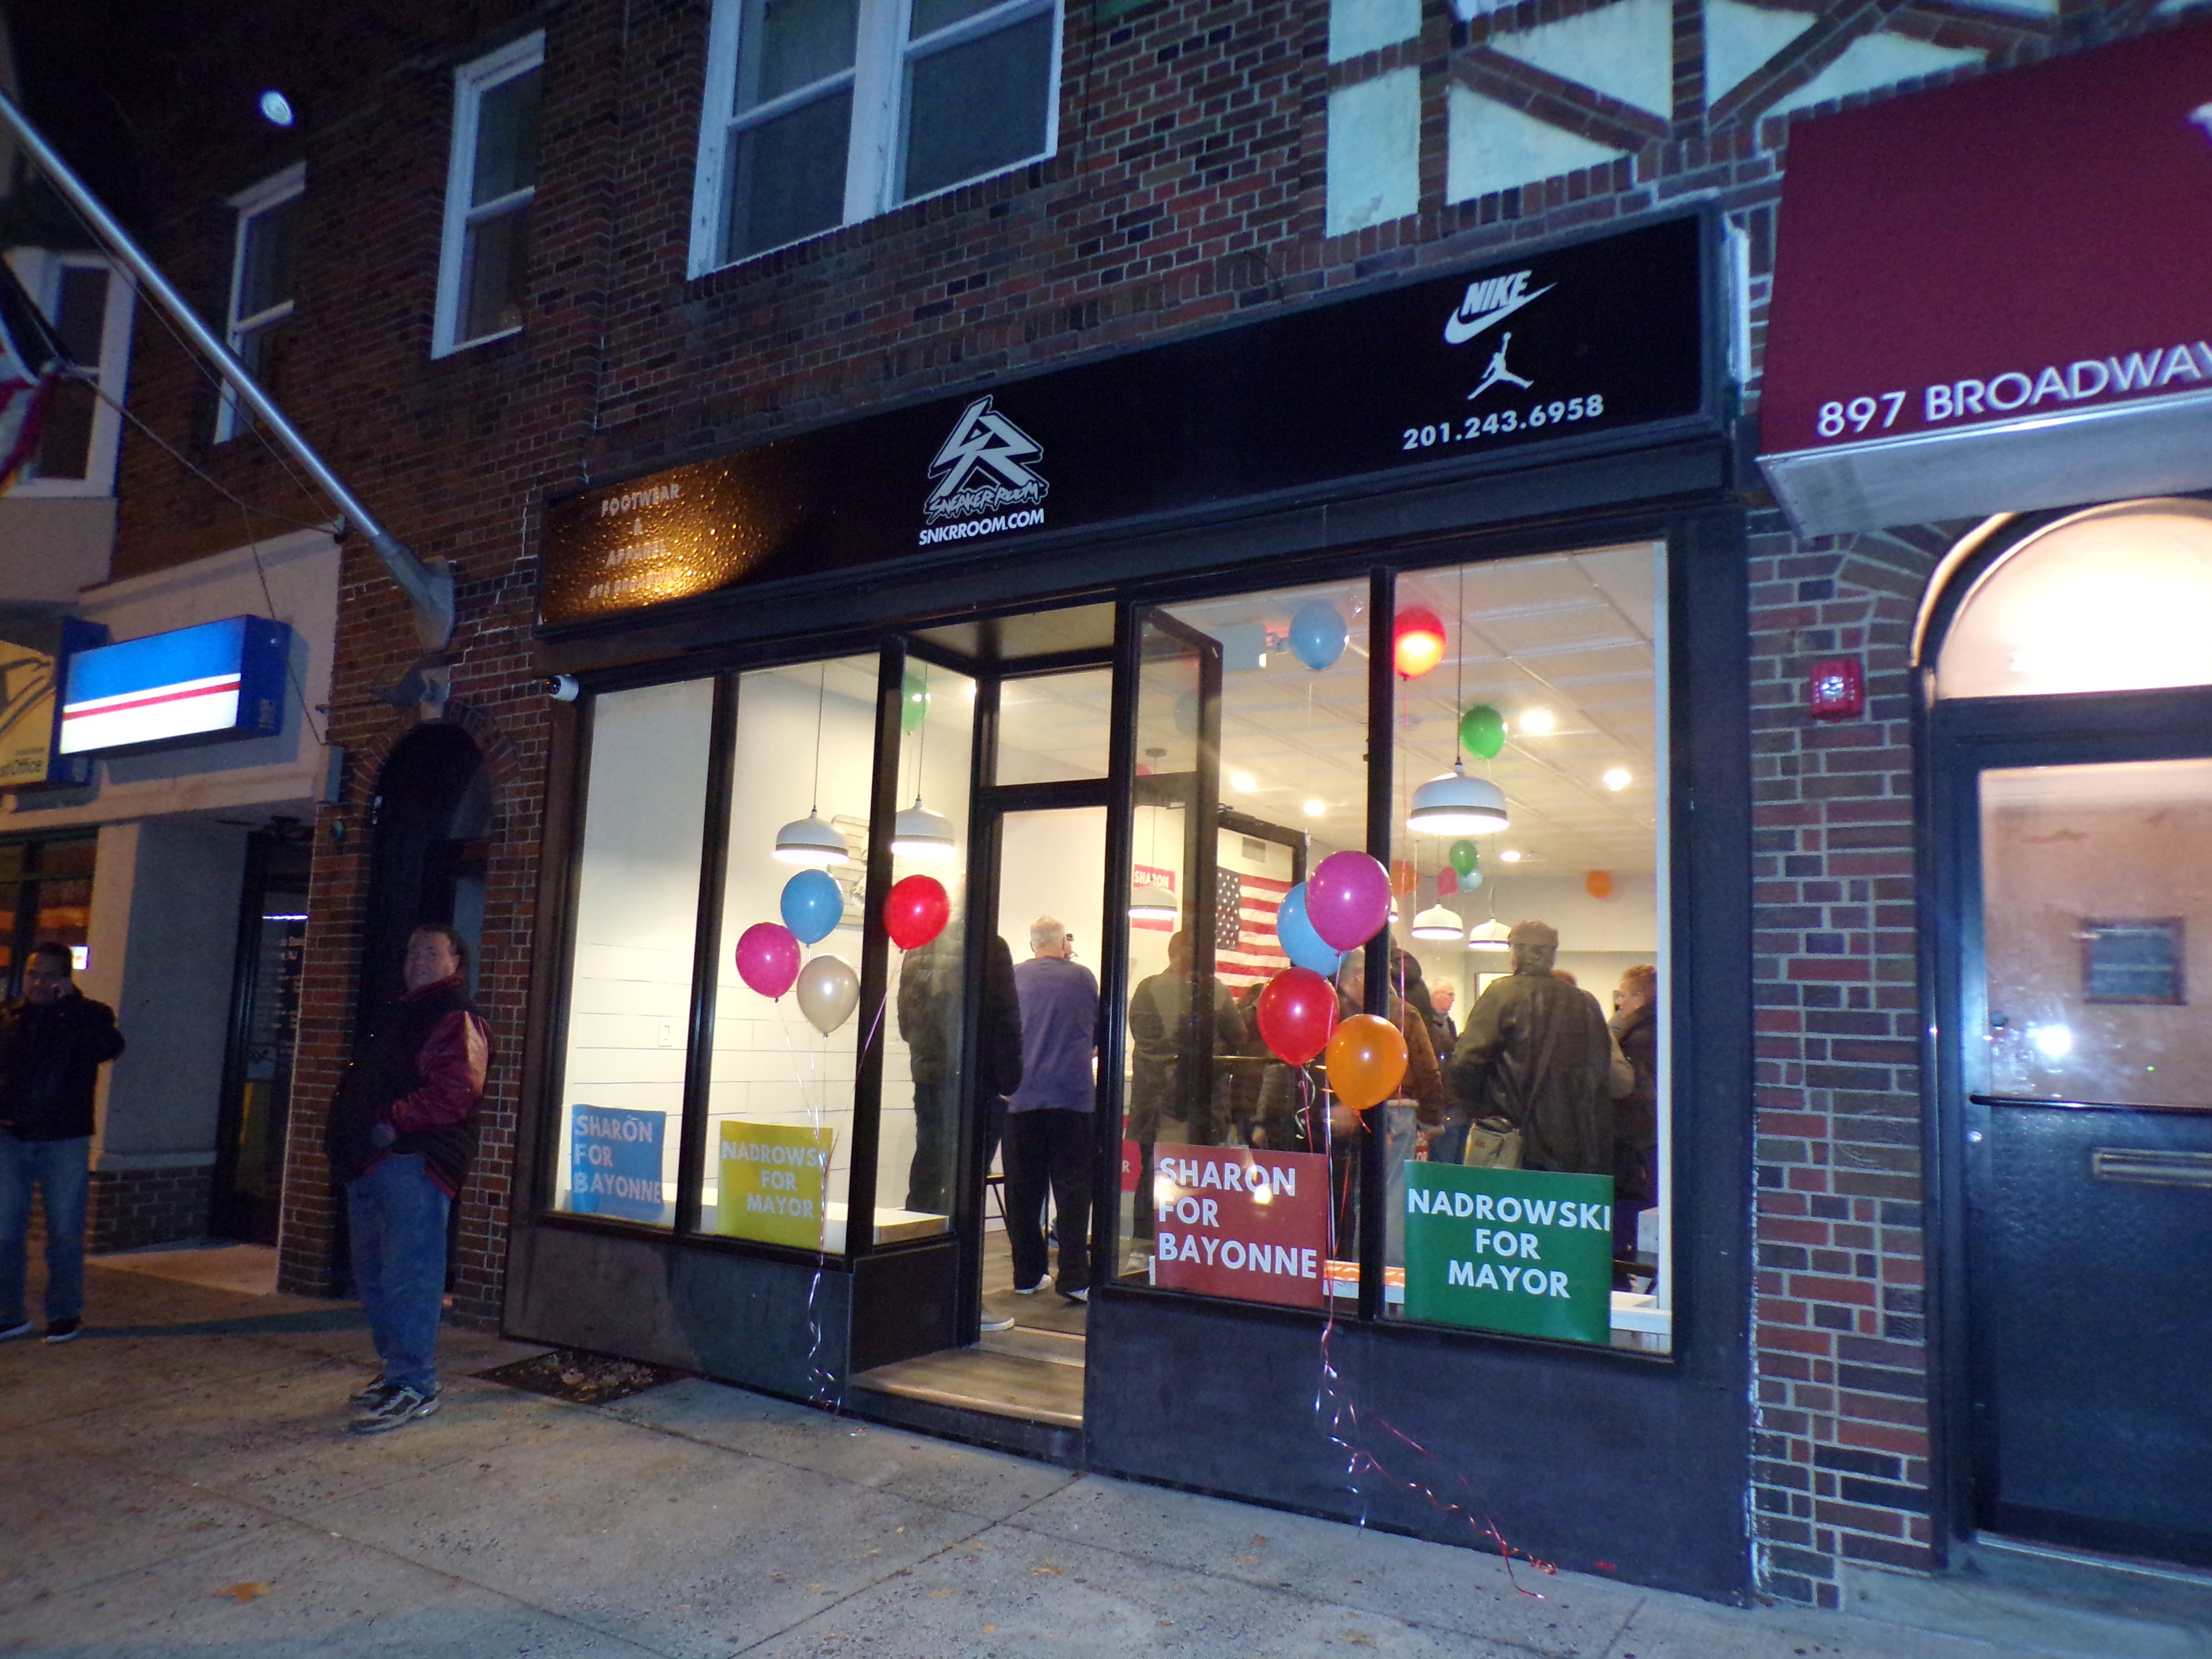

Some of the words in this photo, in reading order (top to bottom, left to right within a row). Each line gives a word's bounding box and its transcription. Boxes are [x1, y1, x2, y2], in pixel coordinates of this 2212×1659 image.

[1461, 270, 1532, 316] NIKE
[1403, 394, 1604, 450] 201.243.6958
[1817, 391, 1906, 438] 897
[601, 484, 680, 517] FOOTWEAR
[995, 481, 1038, 507] ROOM
[919, 508, 1045, 545] SNKRROOM.COM
[576, 1116, 653, 1142] SHARON
[575, 1143, 613, 1167] FOR
[574, 1172, 662, 1202] BAYONNE
[761, 1169, 798, 1191] FOR
[1159, 1157, 1295, 1196] SHARON
[747, 1193, 814, 1219] MAYOR
[1158, 1196, 1220, 1227] FOR
[1408, 1188, 1611, 1232] NADROWSKI
[1159, 1232, 1317, 1279] BAYONNE
[1475, 1228, 1541, 1260] FOR
[1448, 1260, 1571, 1298] MAYOR
